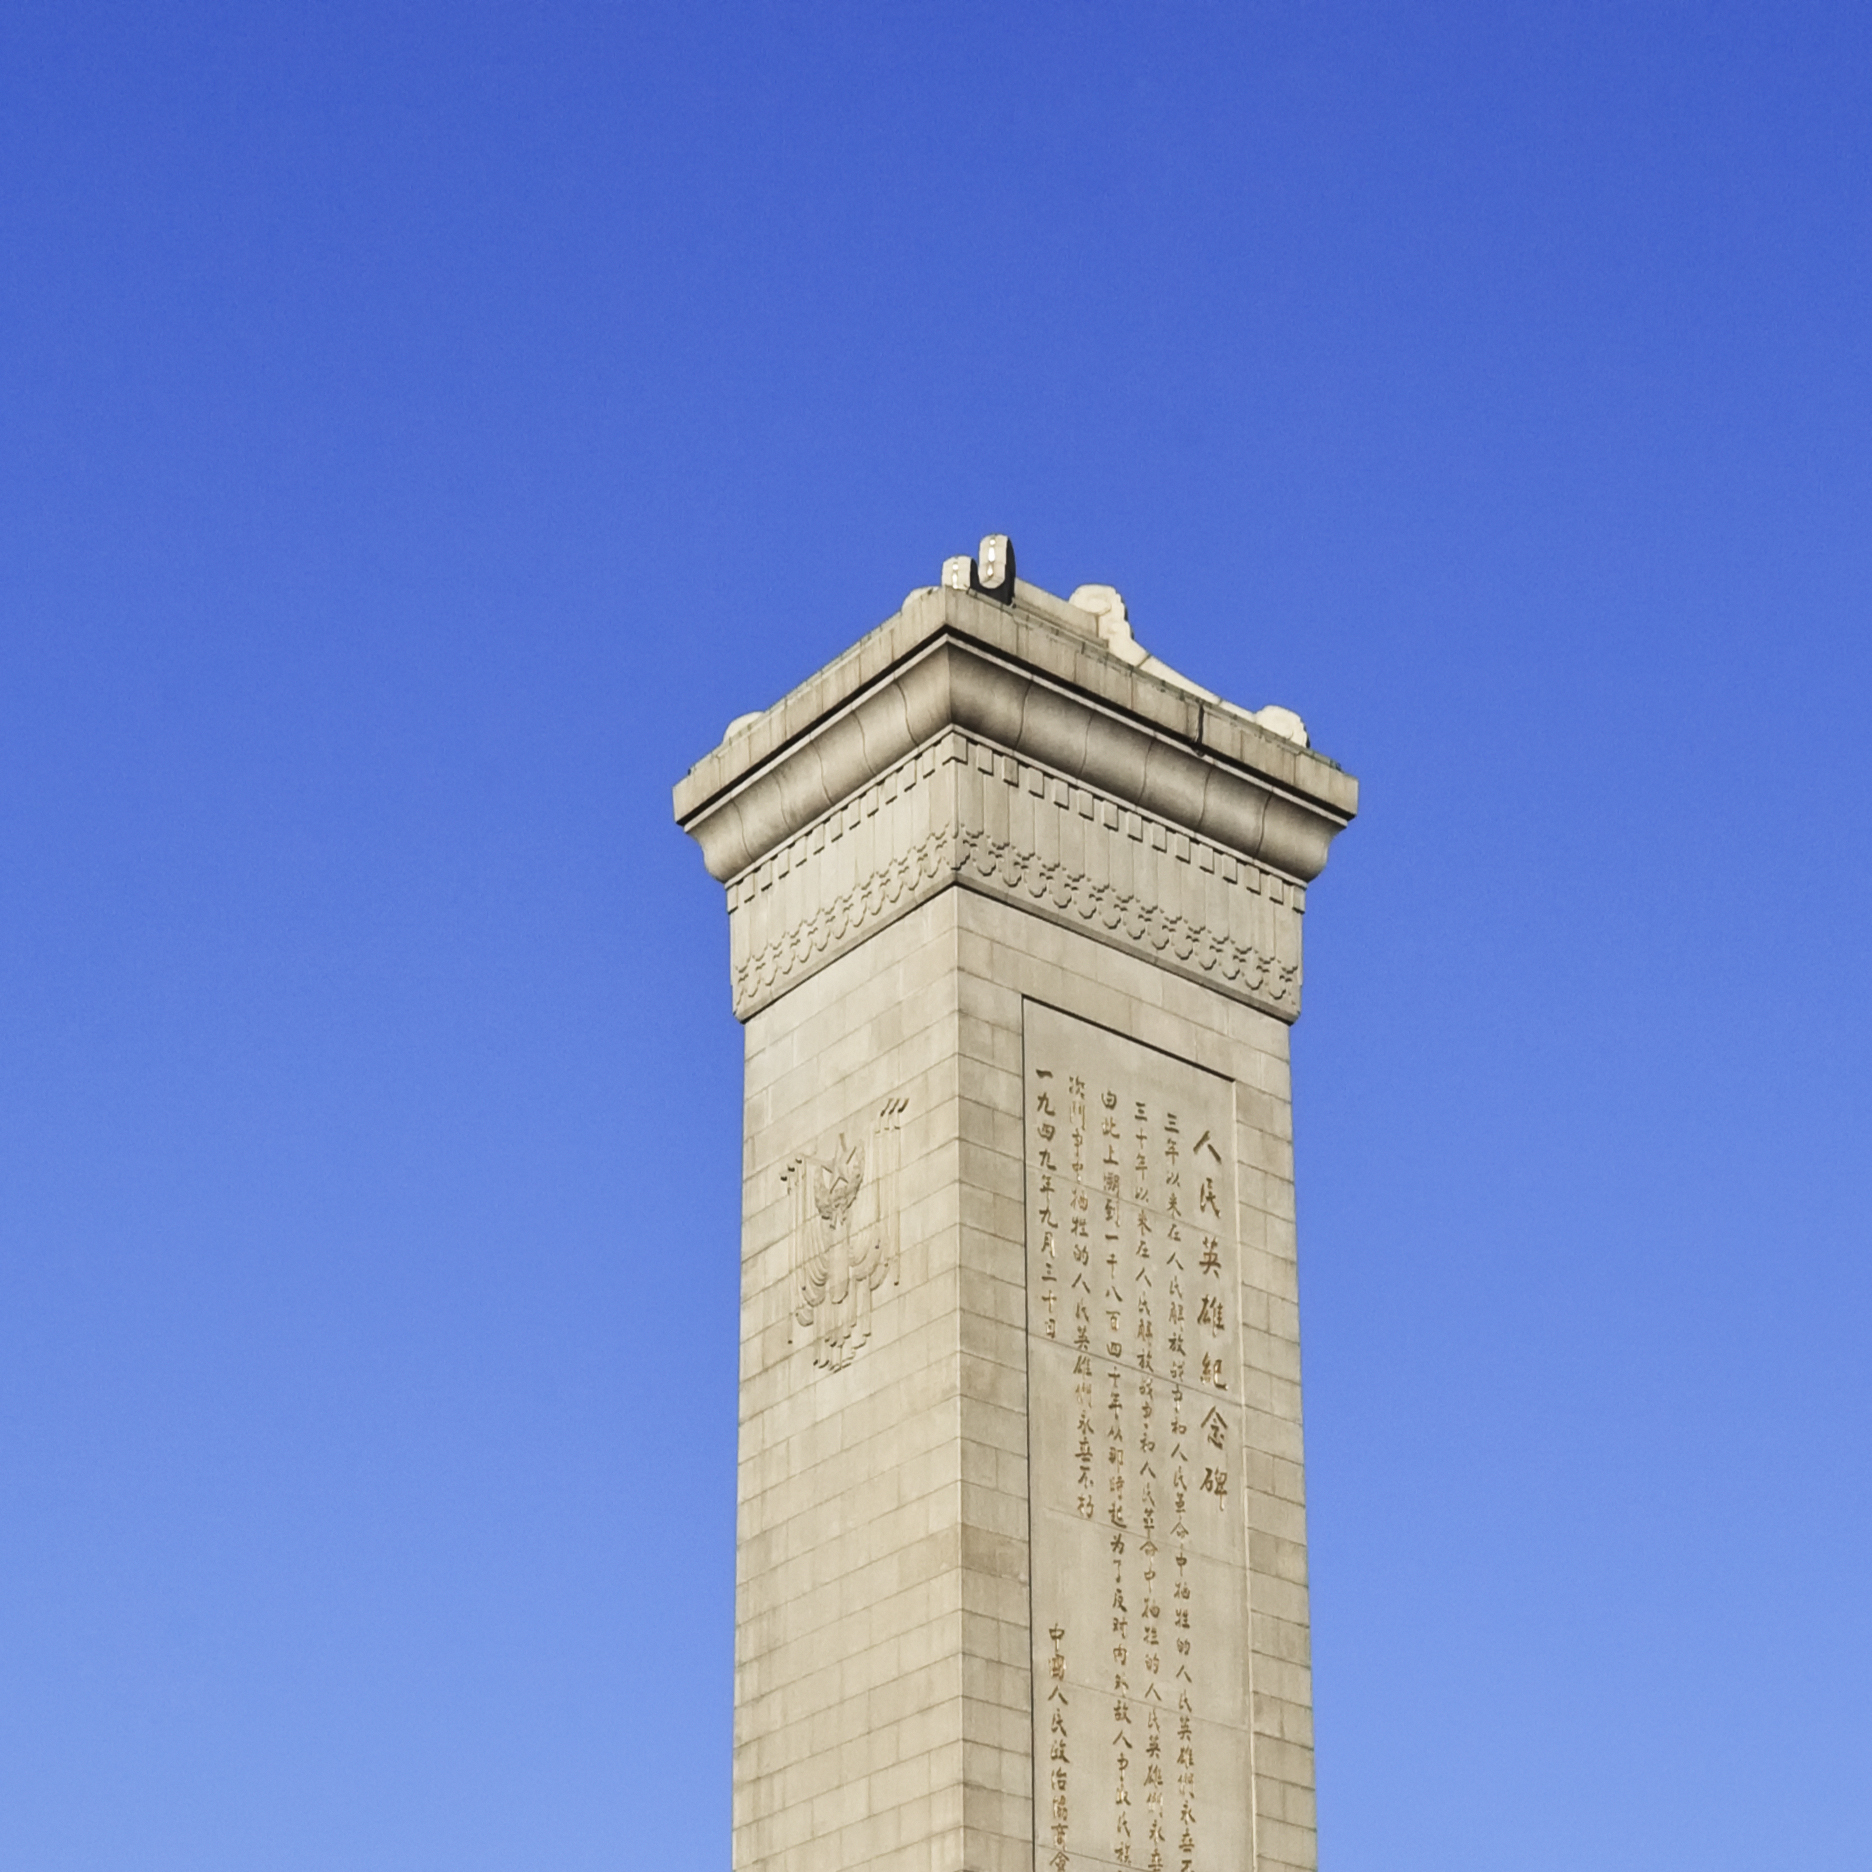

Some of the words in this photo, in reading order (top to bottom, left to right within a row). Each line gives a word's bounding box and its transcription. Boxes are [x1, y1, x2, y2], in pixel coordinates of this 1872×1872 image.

[1035, 1069, 1059, 1339] 一九四九年九月三十日
